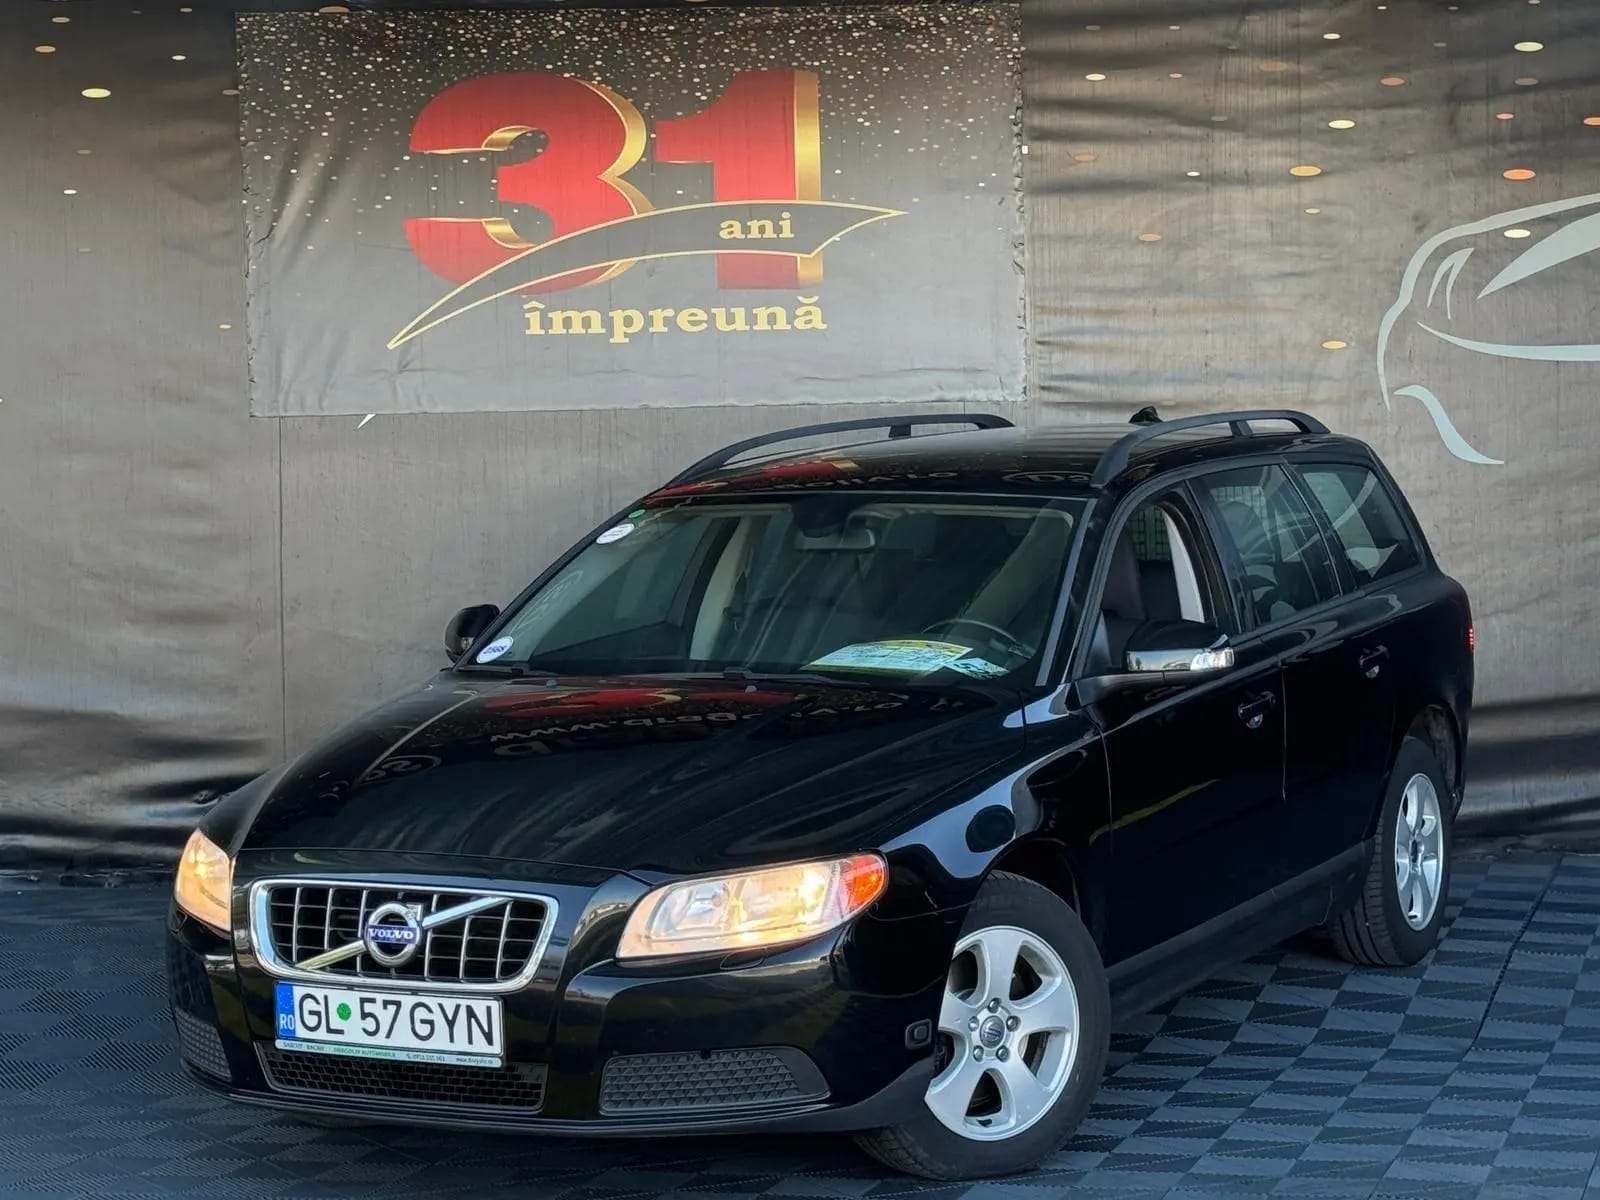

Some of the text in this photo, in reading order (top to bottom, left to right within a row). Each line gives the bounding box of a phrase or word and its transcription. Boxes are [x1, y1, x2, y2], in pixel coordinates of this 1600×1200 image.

[403, 69, 824, 295] 31
[719, 211, 794, 239] ani
[522, 295, 827, 344] împreună
[368, 927, 414, 940] VOLVO
[279, 1013, 295, 1030] RO
[298, 992, 494, 1047] GL 57 GYN
